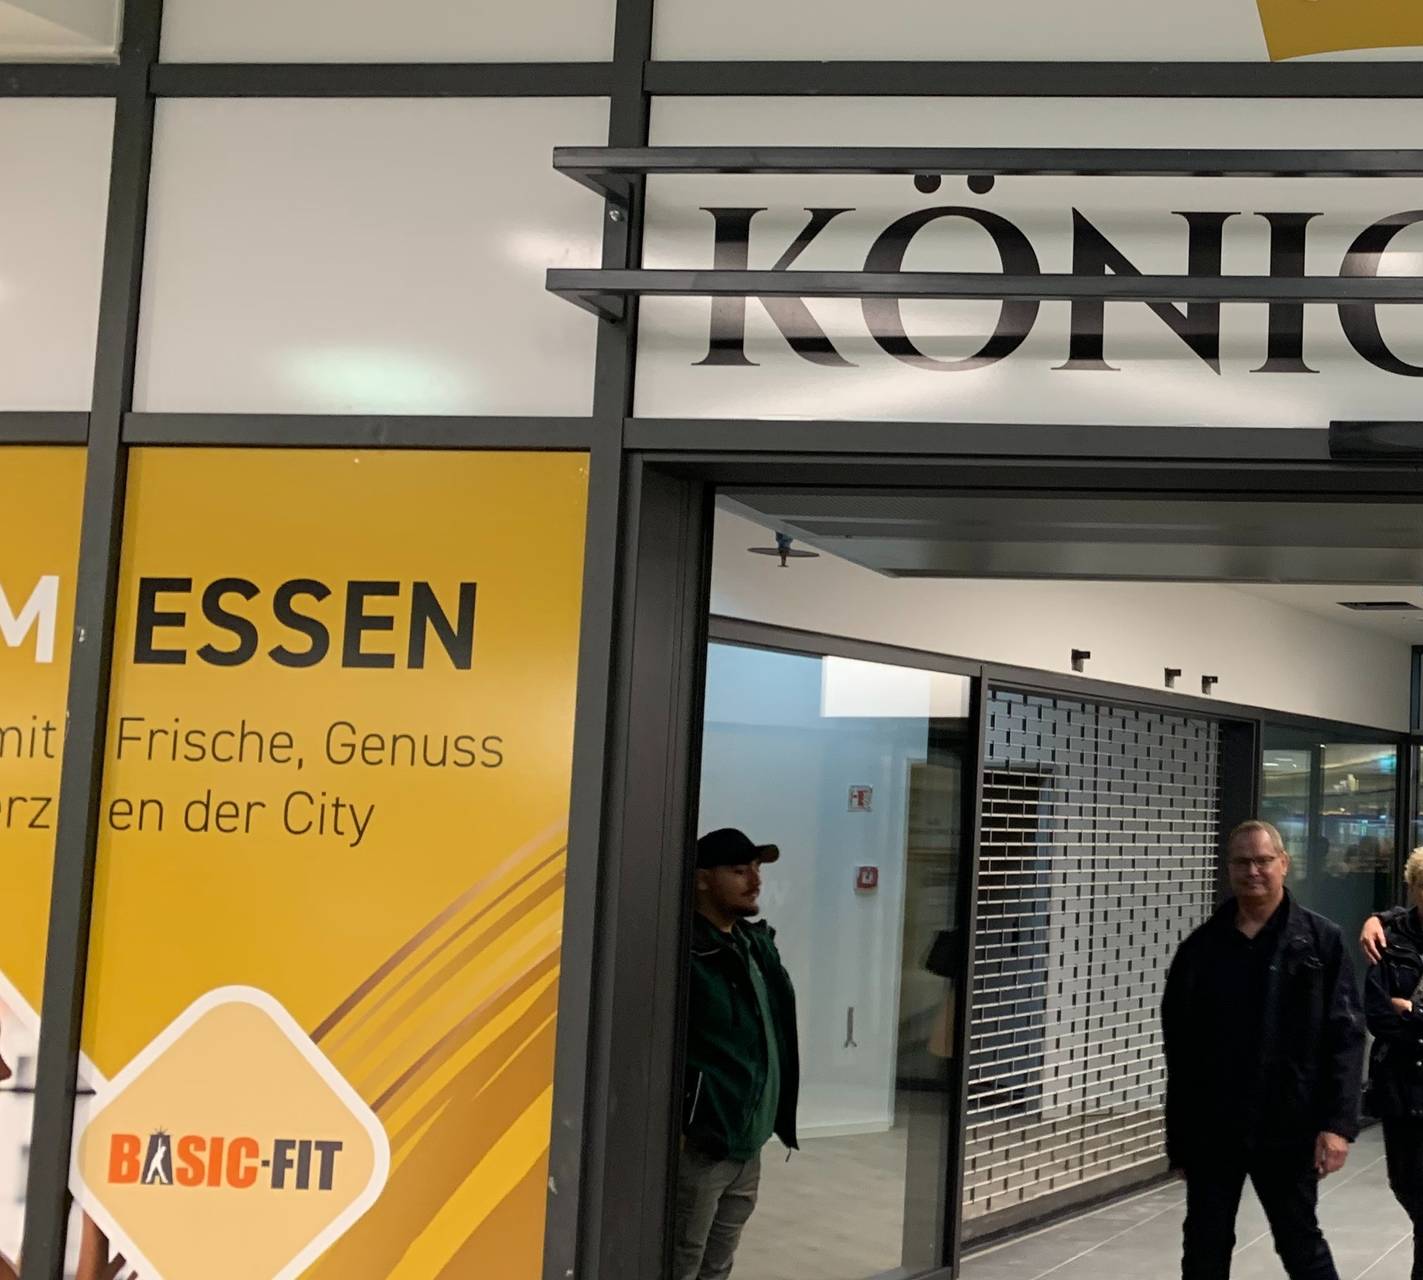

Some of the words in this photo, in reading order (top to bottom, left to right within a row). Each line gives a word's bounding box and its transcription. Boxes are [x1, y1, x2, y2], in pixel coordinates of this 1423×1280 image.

[133, 577, 478, 670] ESSEN
[116, 717, 304, 771] Frische,
[325, 721, 504, 769] Genuss
[183, 789, 266, 834] der
[283, 791, 375, 848] City
[107, 1133, 343, 1191] BASIC-FIT
